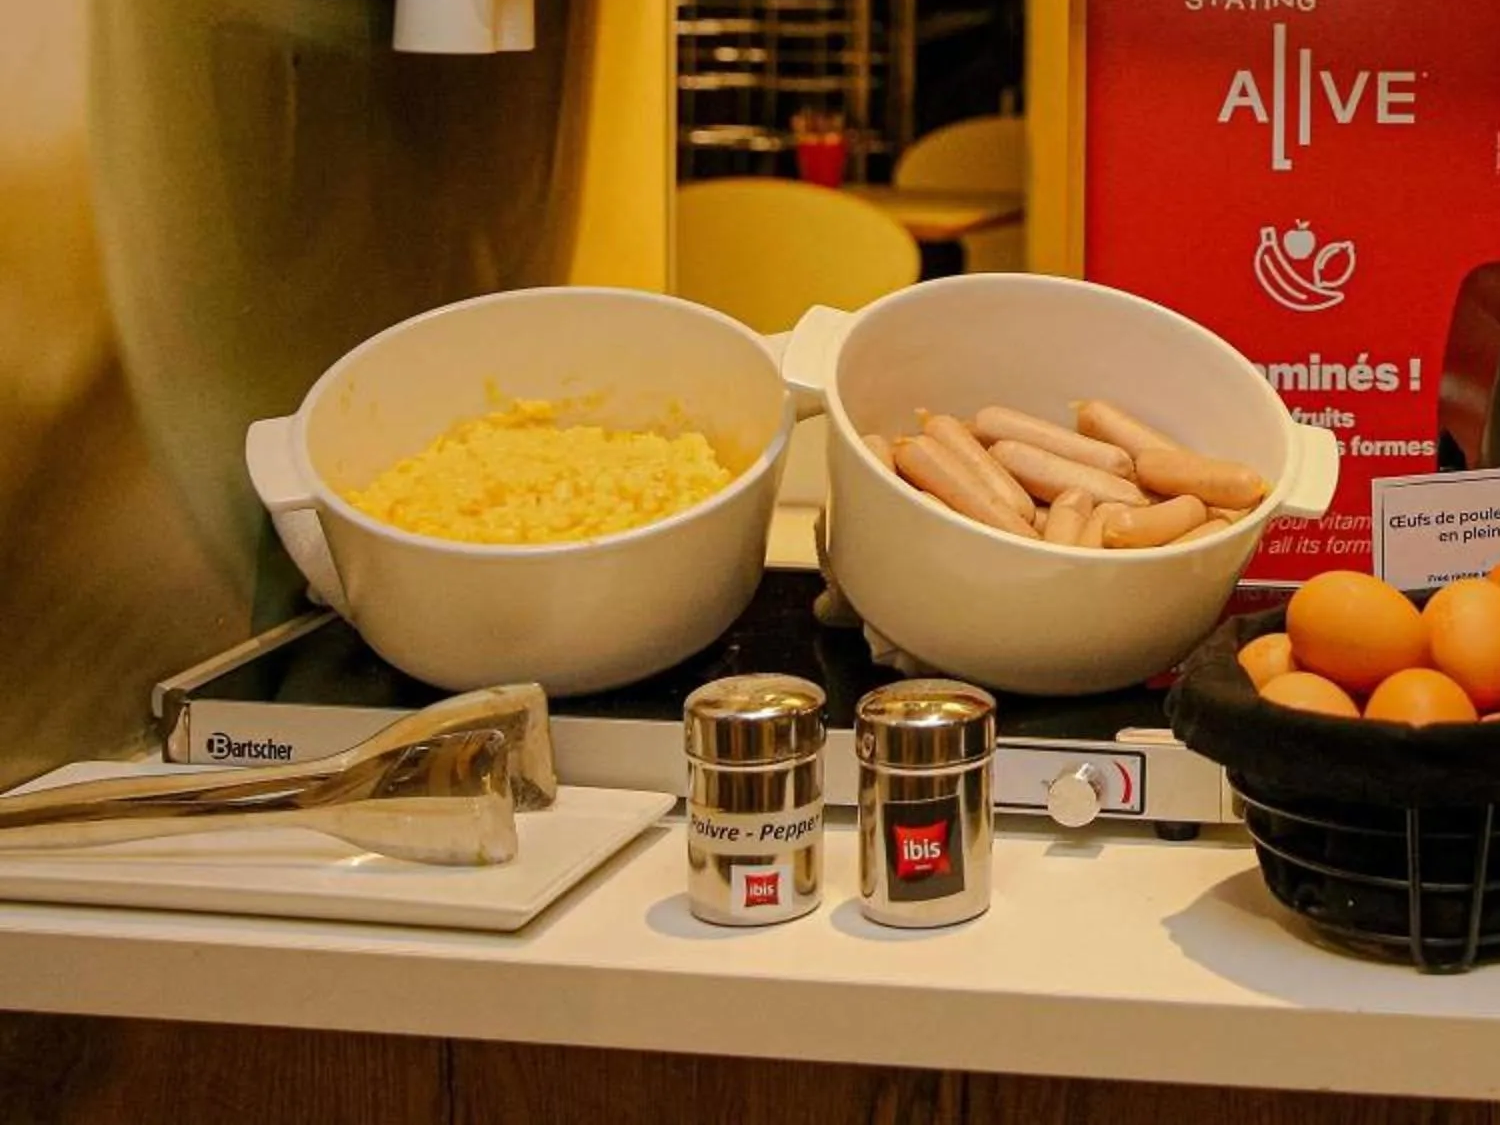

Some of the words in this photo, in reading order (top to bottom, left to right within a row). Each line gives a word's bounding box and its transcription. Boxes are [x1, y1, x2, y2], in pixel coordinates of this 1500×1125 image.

[1218, 23, 1416, 170] ALIVE
[1408, 358, 1422, 392] !
[1351, 435, 1436, 457] formes
[1319, 513, 1372, 530] vitam
[1435, 510, 1455, 525] de
[1268, 536, 1291, 553] all
[1295, 535, 1320, 553] its
[1326, 535, 1372, 553] form
[1438, 531, 1459, 542] en
[1463, 526, 1500, 543] plein
[206, 732, 293, 761] Bartscher
[902, 838, 941, 861] ibis
[749, 882, 775, 896] ibis
